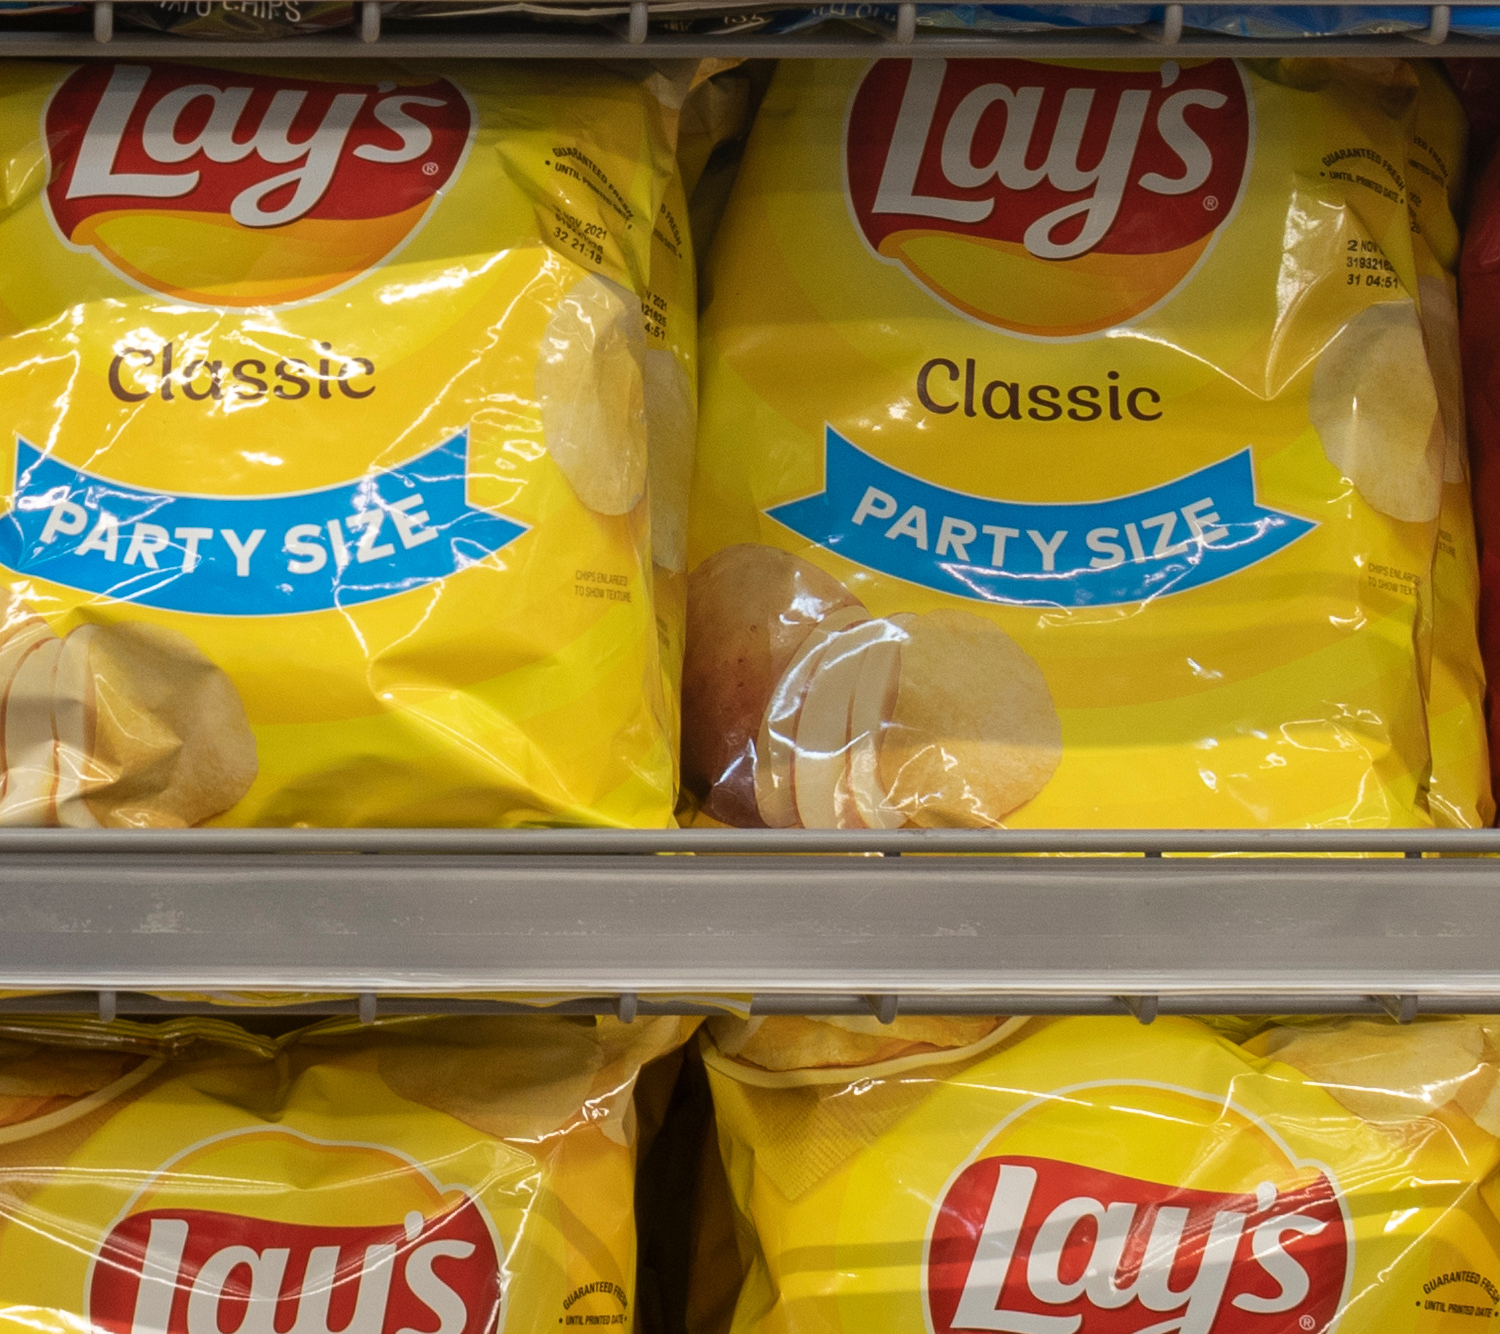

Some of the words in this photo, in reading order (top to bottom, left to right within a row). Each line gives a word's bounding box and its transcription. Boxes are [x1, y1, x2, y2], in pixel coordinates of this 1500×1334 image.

[872, 57, 1228, 259] Lay's
[1322, 148, 1382, 167] GUARANTEED
[572, 238, 602, 265] 21:18
[1347, 273, 1361, 286] 31
[1366, 274, 1400, 289] 04:51
[108, 341, 376, 404] Classic
[916, 356, 1164, 422] Classic
[37, 499, 266, 576] PARTY
[283, 494, 439, 574] SIZE
[851, 485, 1069, 571] PARTY
[1084, 497, 1229, 569] SIZE
[575, 570, 597, 583] CHIPS
[597, 573, 629, 586] ENLARGED
[562, 1281, 611, 1310] GUARANTEED
[611, 1282, 628, 1310] FRESH
[1423, 1271, 1481, 1295] GUARANTEED
[1480, 1278, 1500, 1305] FRESH
[565, 1315, 583, 1326] UNTIL
[585, 1315, 610, 1325] PRINTED
[610, 1314, 624, 1324] DATE
[1425, 1301, 1446, 1313] UNTIL
[1447, 1304, 1474, 1317] PRINTED
[1474, 1306, 1493, 1319] DATE
